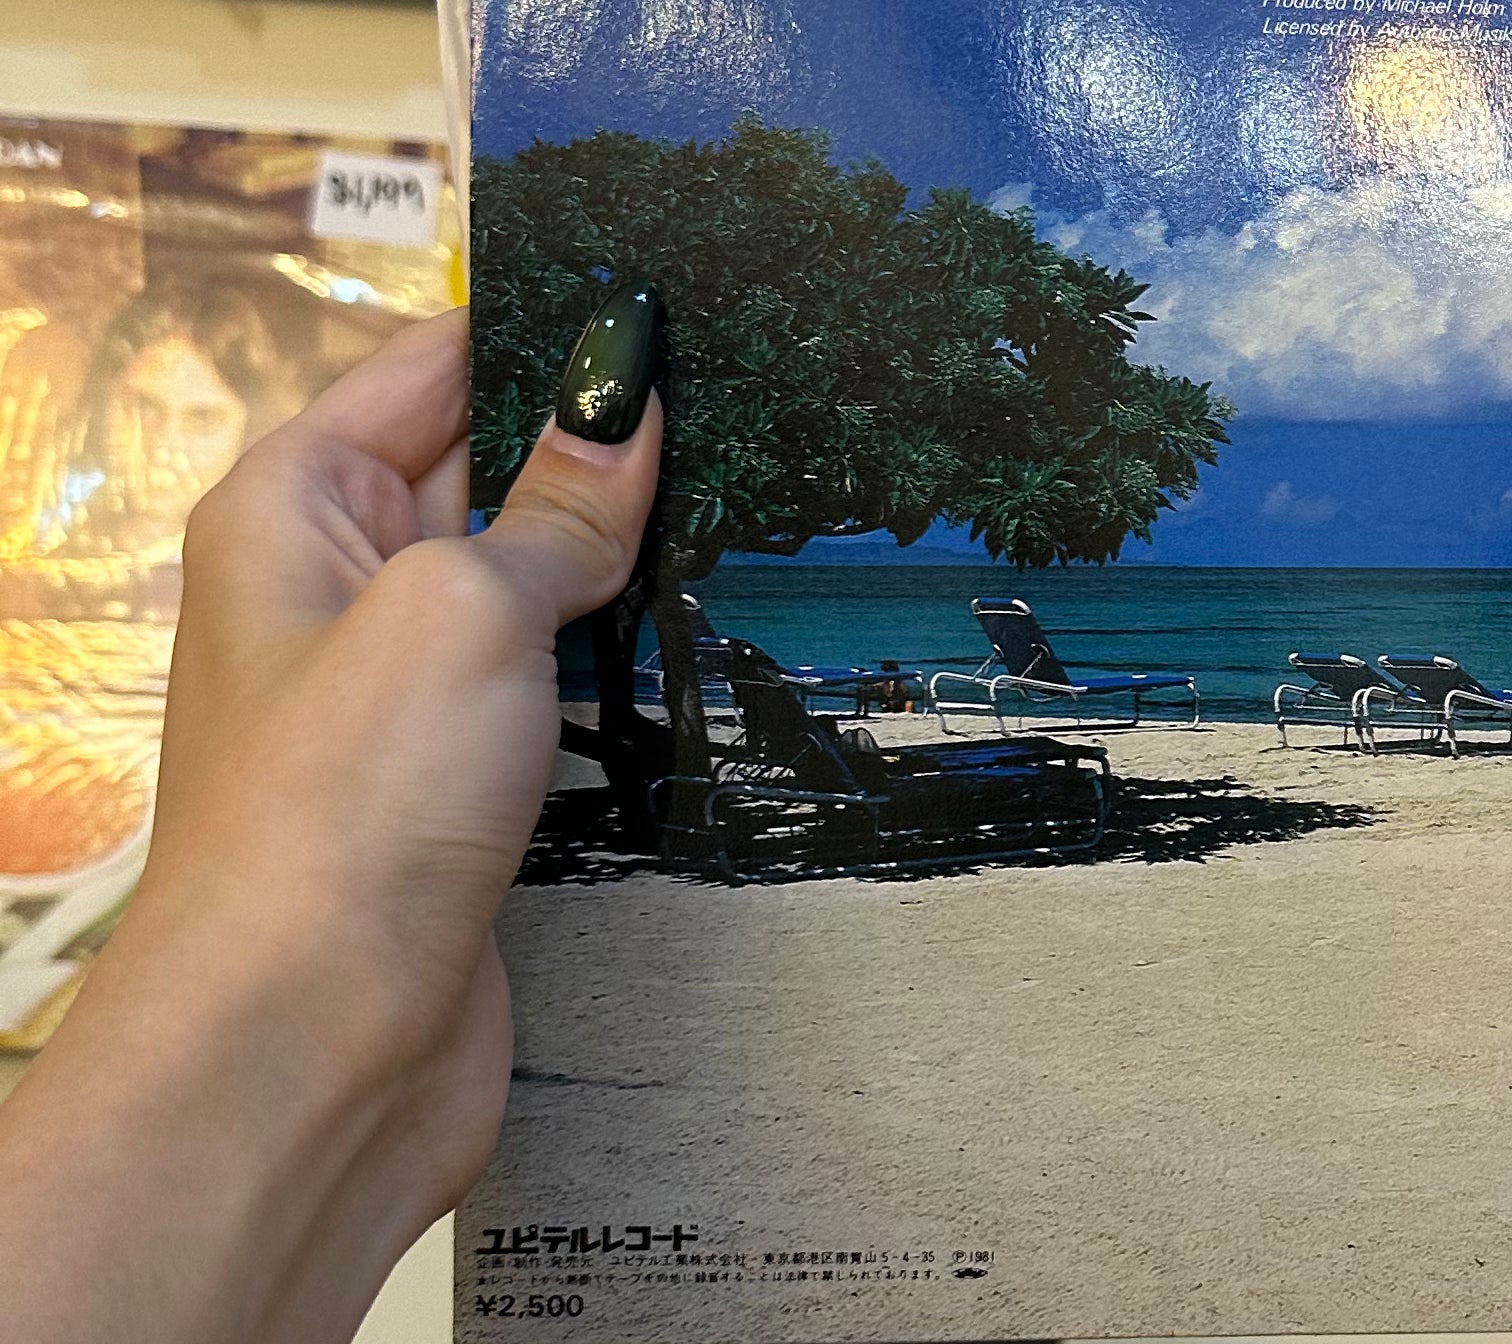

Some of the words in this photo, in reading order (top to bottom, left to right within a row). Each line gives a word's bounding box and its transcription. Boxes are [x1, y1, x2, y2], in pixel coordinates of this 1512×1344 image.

[1262, 17, 1343, 37] Licensed
[1349, 19, 1371, 39] by
[475, 1294, 584, 1319] ¥2,500
